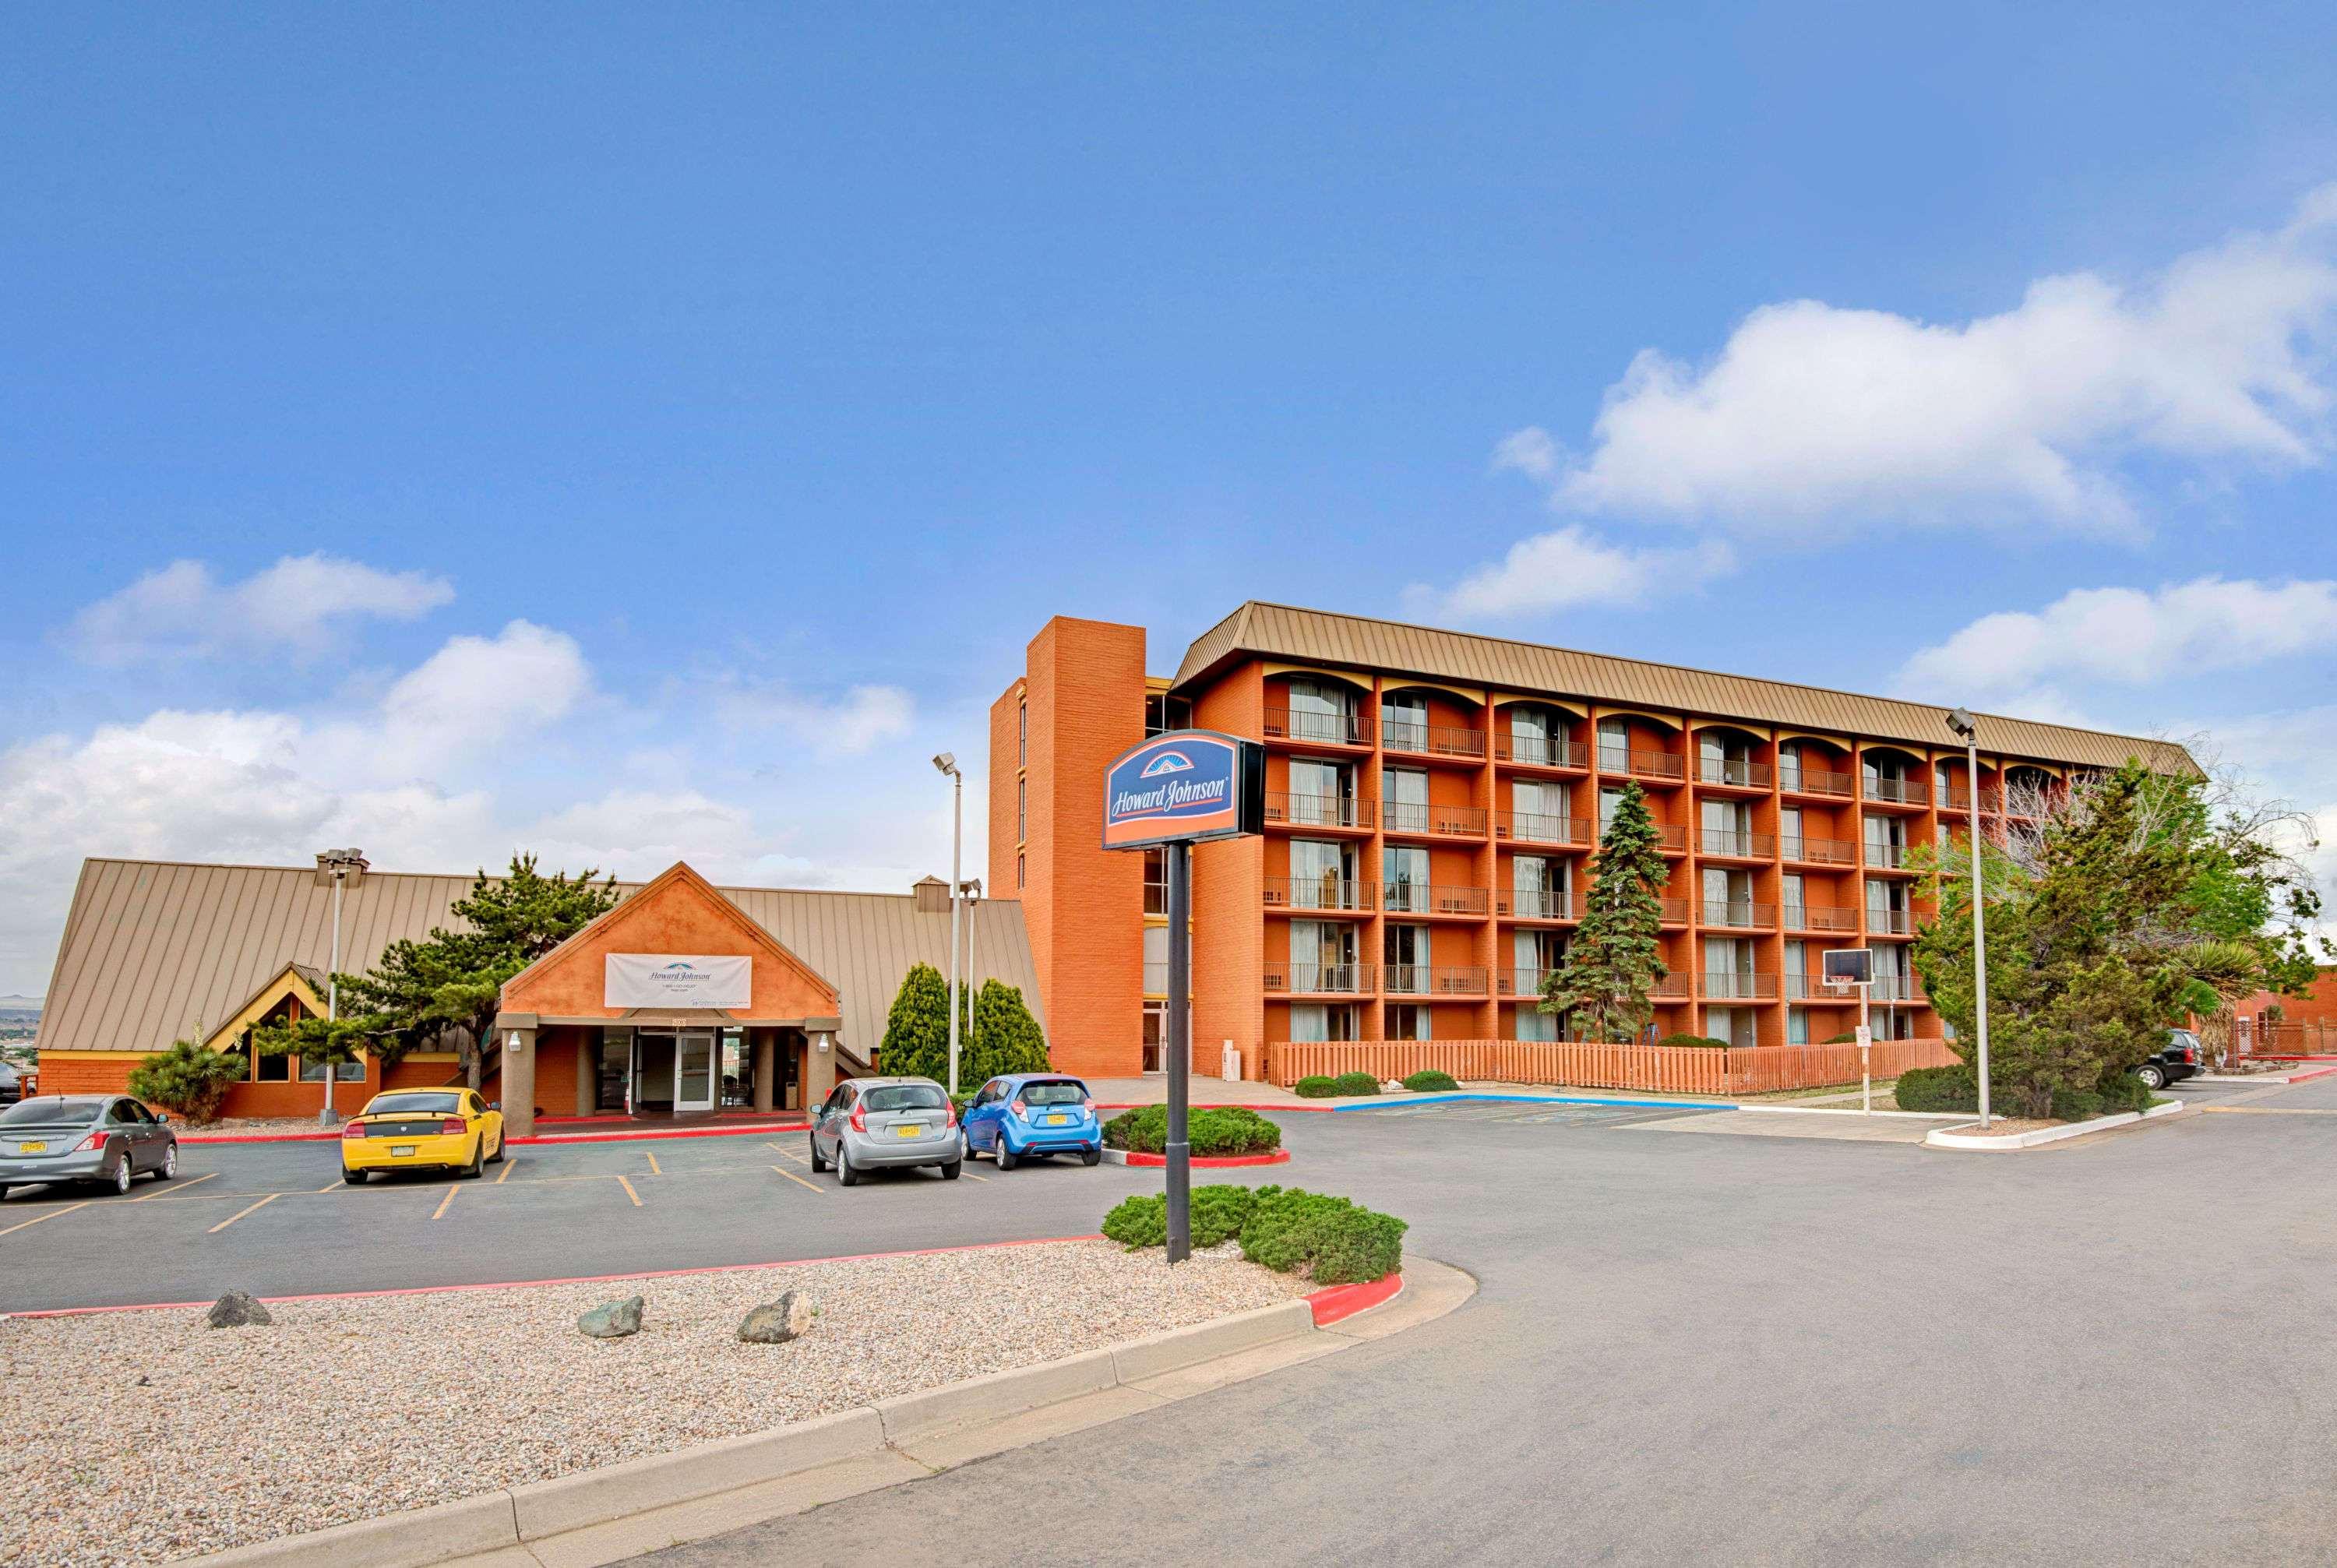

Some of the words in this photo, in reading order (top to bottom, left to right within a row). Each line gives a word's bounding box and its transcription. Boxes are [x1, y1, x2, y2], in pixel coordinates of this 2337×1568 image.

[1112, 784, 1165, 816] Howard
[1163, 778, 1225, 812] Johnson
[648, 972, 679, 981] Howard
[679, 972, 711, 981] Johnson
